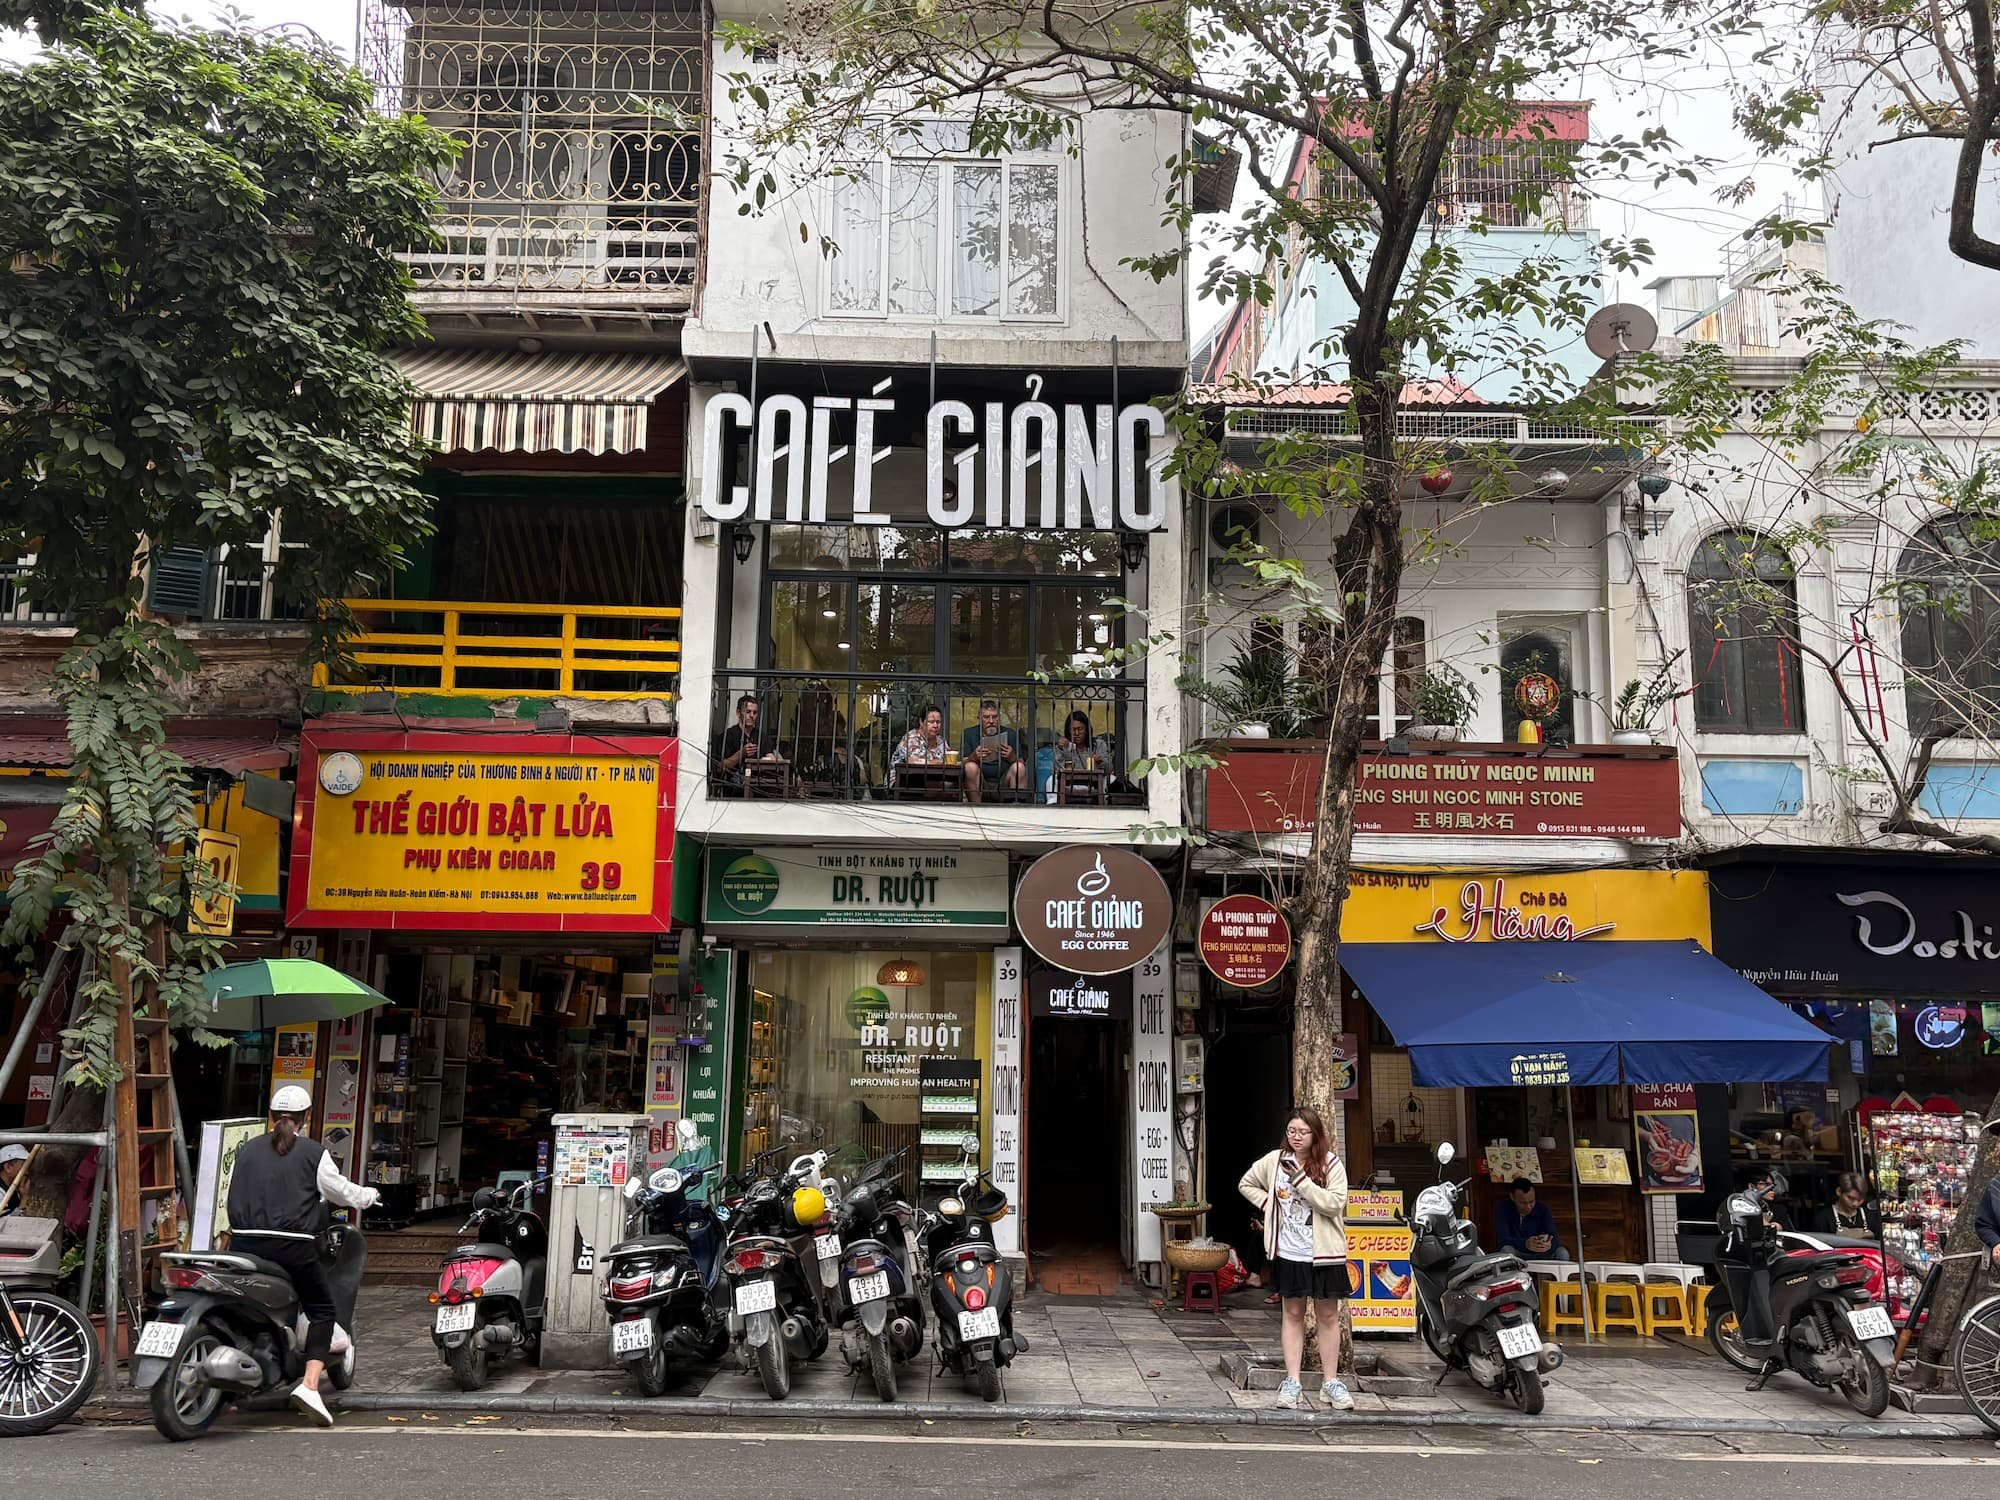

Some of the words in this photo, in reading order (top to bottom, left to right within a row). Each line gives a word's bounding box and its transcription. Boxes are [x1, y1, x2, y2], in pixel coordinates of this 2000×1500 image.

[701, 375, 895, 523] CAFÉ
[926, 373, 1172, 531] GIẢNG
[370, 760, 384, 780] HỘI
[388, 763, 418, 778] DOANH
[421, 762, 454, 781] NGHIỆP
[458, 759, 476, 778] CỦA
[480, 764, 517, 780] THƯƠNG
[520, 765, 543, 780] BINH
[545, 765, 551, 780] &
[555, 762, 582, 781] NGƯỜI
[586, 767, 598, 781] KT
[609, 767, 620, 781] TP
[624, 764, 636, 781] HÀ
[639, 764, 654, 784] NỘI
[1363, 763, 1427, 782] PHONG
[1433, 759, 1482, 783] THỦY
[1486, 764, 1538, 786] NGỌC
[1544, 767, 1595, 783] MINH
[328, 783, 353, 791] VAIDE
[1353, 789, 1385, 804] ENG
[1392, 789, 1428, 805] SHUI
[1433, 789, 1480, 806] NGOC
[1485, 790, 1525, 806] MINH
[1530, 791, 1583, 807] STONE
[352, 790, 412, 834] THẾ
[417, 794, 478, 836] GIỚI
[488, 796, 546, 842] BẬT
[555, 792, 614, 837] LỬA
[404, 848, 440, 873] PHỤ
[499, 850, 556, 870] CIGAR
[817, 856, 842, 867] TINH
[846, 854, 864, 868] BỘT
[870, 854, 904, 867] KHÁNG
[909, 856, 922, 869] TỰ
[925, 855, 957, 868] NHIÊN
[581, 862, 621, 890] 39
[1349, 874, 1365, 887] NG
[832, 875, 870, 903] DR.
[879, 871, 939, 908] RUỘT
[1045, 896, 1086, 928] CAFÉ
[1091, 894, 1143, 929] GIẢNG
[1212, 910, 1224, 924] ĐÁ
[1225, 912, 1254, 924] PHONG
[1256, 910, 1277, 924] THỦY
[1075, 930, 1094, 938] Since
[1096, 930, 1115, 938] 1946
[1220, 926, 1244, 939] NGỌC
[1246, 926, 1269, 937] MINH
[1061, 941, 1084, 950] EGG
[1087, 941, 1130, 950] COFFEE
[1203, 942, 1220, 951] FENG
[1220, 943, 1233, 951] SHUI
[1251, 943, 1266, 952] MINH
[1267, 943, 1287, 953] STONE
[999, 968, 1017, 980] 39
[1143, 964, 1160, 976] 39
[1050, 986, 1076, 1007] CAFÉ
[1077, 986, 1109, 1009] GIẢNG
[998, 994, 1017, 1039] CAFÉ
[1139, 989, 1164, 1035] CAFÉ
[860, 1025, 897, 1046] DR.
[905, 1022, 962, 1051] RUỘT
[865, 1054, 918, 1063] RESISTANT
[851, 1078, 900, 1087] IMPROVING
[937, 1078, 971, 1087] HEALTH
[1635, 1083, 1660, 1094] NEM
[1664, 1082, 1694, 1093] CHUA
[1654, 1094, 1678, 1108] RÁN
[1001, 1130, 1012, 1151] EGG
[1147, 1128, 1162, 1149] EGG
[995, 1162, 1016, 1183] COFFEE
[1141, 1158, 1168, 1180] COFFEE
[1360, 1236, 1409, 1251] CHEESE
[857, 1285, 884, 1301] 1532
